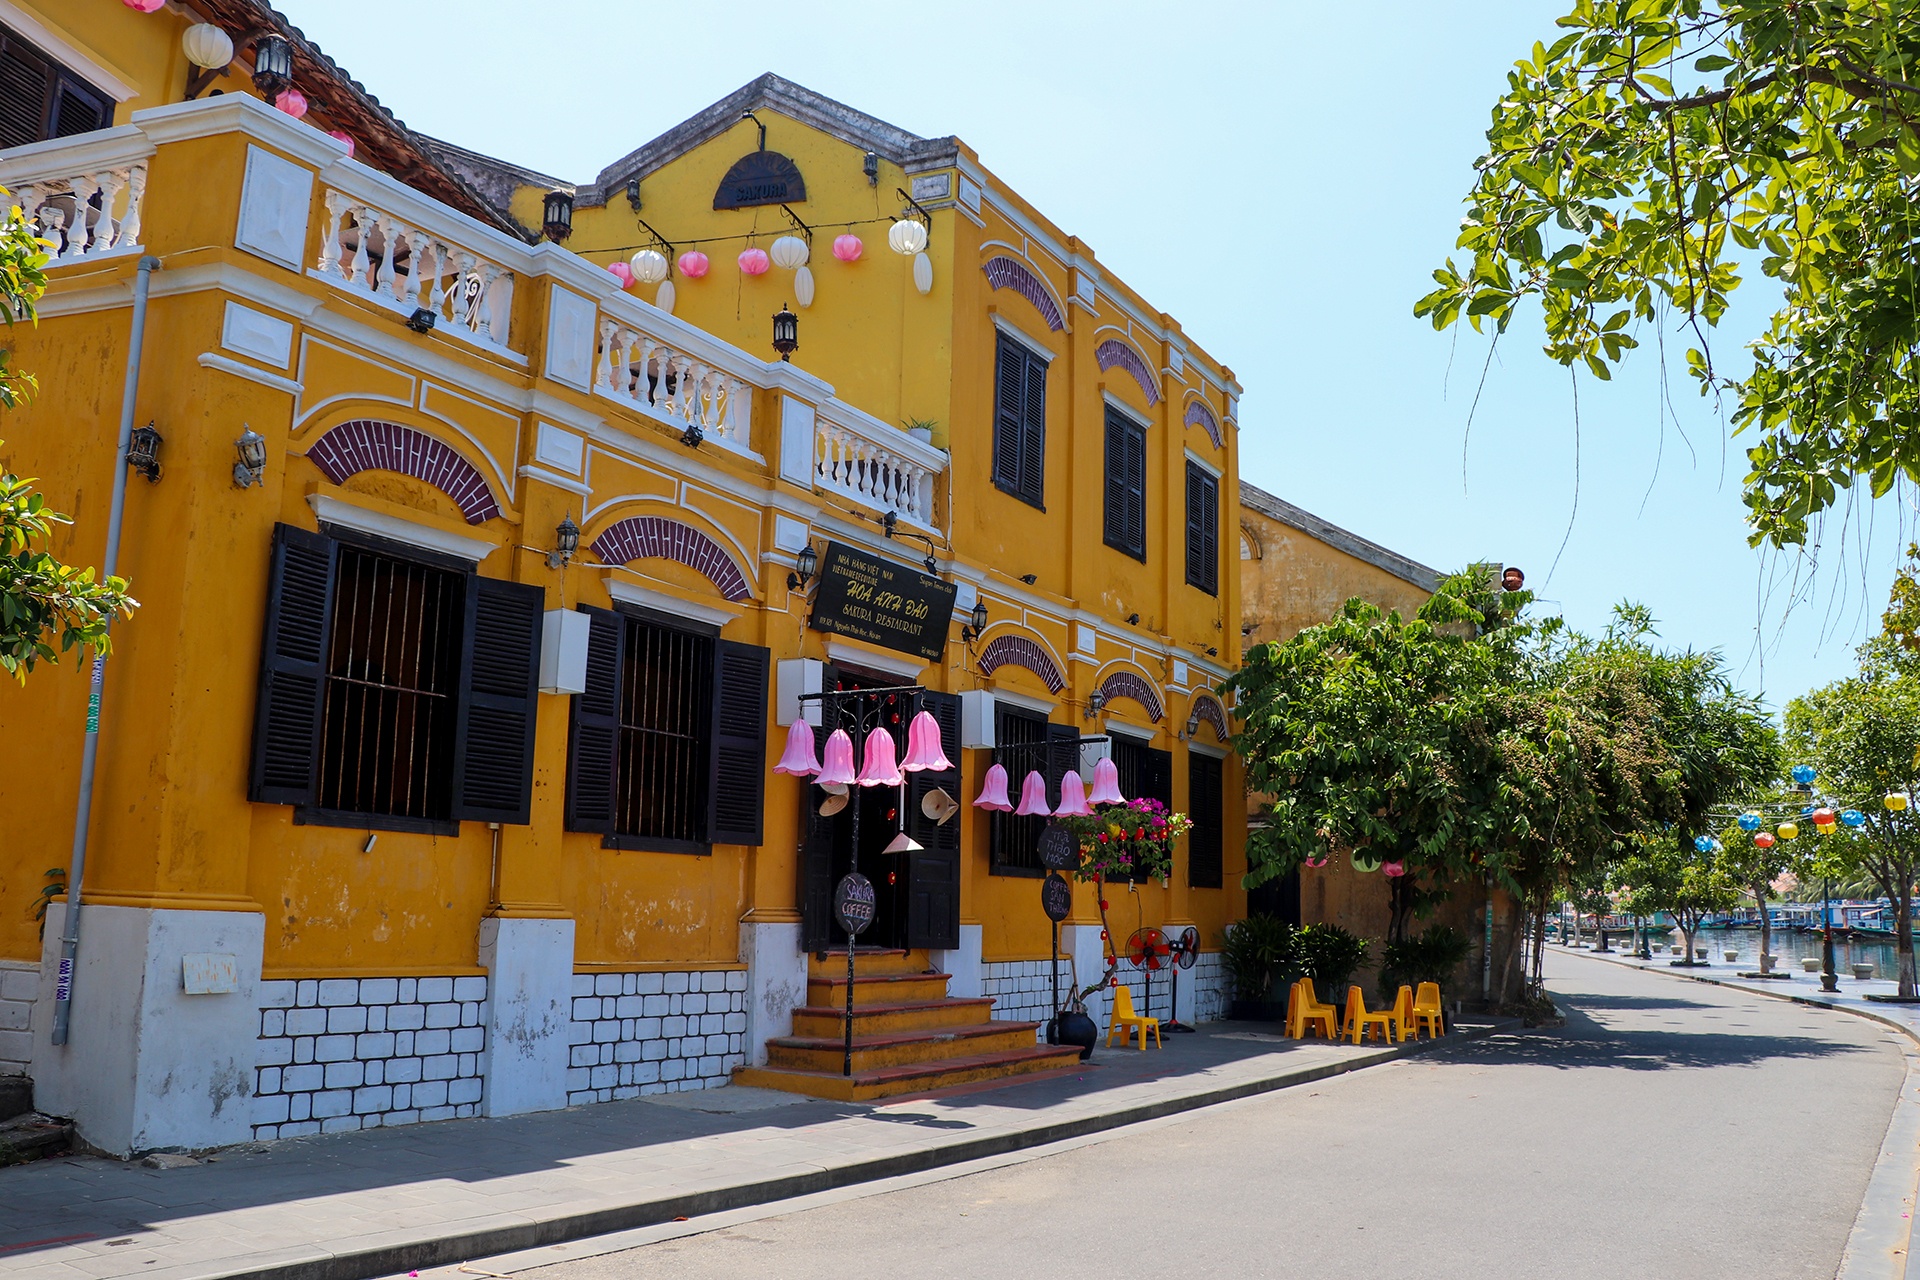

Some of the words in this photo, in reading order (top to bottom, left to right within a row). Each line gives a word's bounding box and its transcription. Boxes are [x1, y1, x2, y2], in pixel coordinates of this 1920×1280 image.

[736, 183, 787, 201] SAKURA
[837, 554, 850, 566] NHÀ
[851, 559, 867, 572] HÀNG
[882, 570, 894, 580] NAM
[846, 580, 873, 602] HOA
[873, 591, 903, 612] ANH
[904, 598, 929, 620] ĐÀO
[842, 603, 872, 622] SAKURA
[875, 613, 923, 636] RESTAURANT
[847, 883, 874, 901] SAKURA
[842, 902, 871, 918] COFFEE
